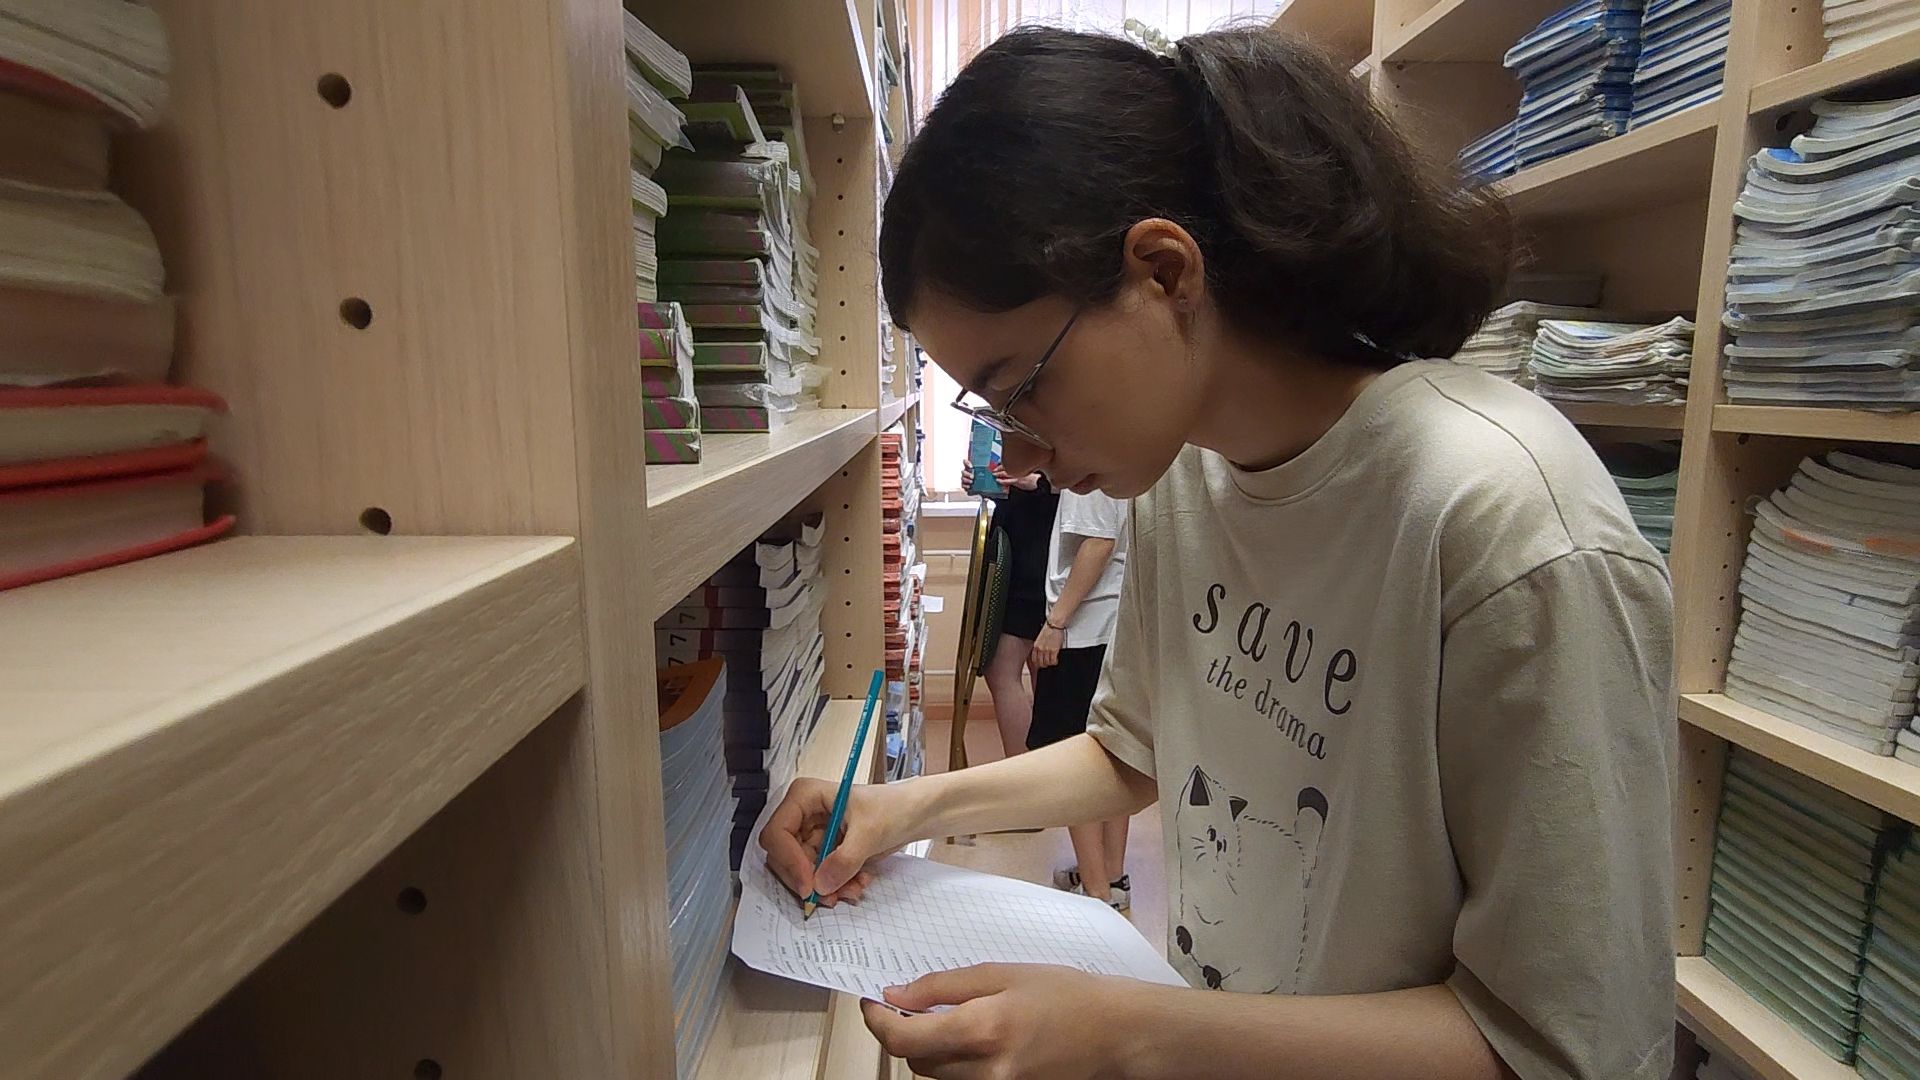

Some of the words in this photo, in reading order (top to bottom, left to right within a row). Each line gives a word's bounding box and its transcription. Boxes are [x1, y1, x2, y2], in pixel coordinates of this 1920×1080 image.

[670, 633, 687, 646] 7
[680, 613, 696, 624] 7
[1193, 583, 1357, 716] save
[1206, 655, 1247, 699] the
[1254, 678, 1327, 760] drama
